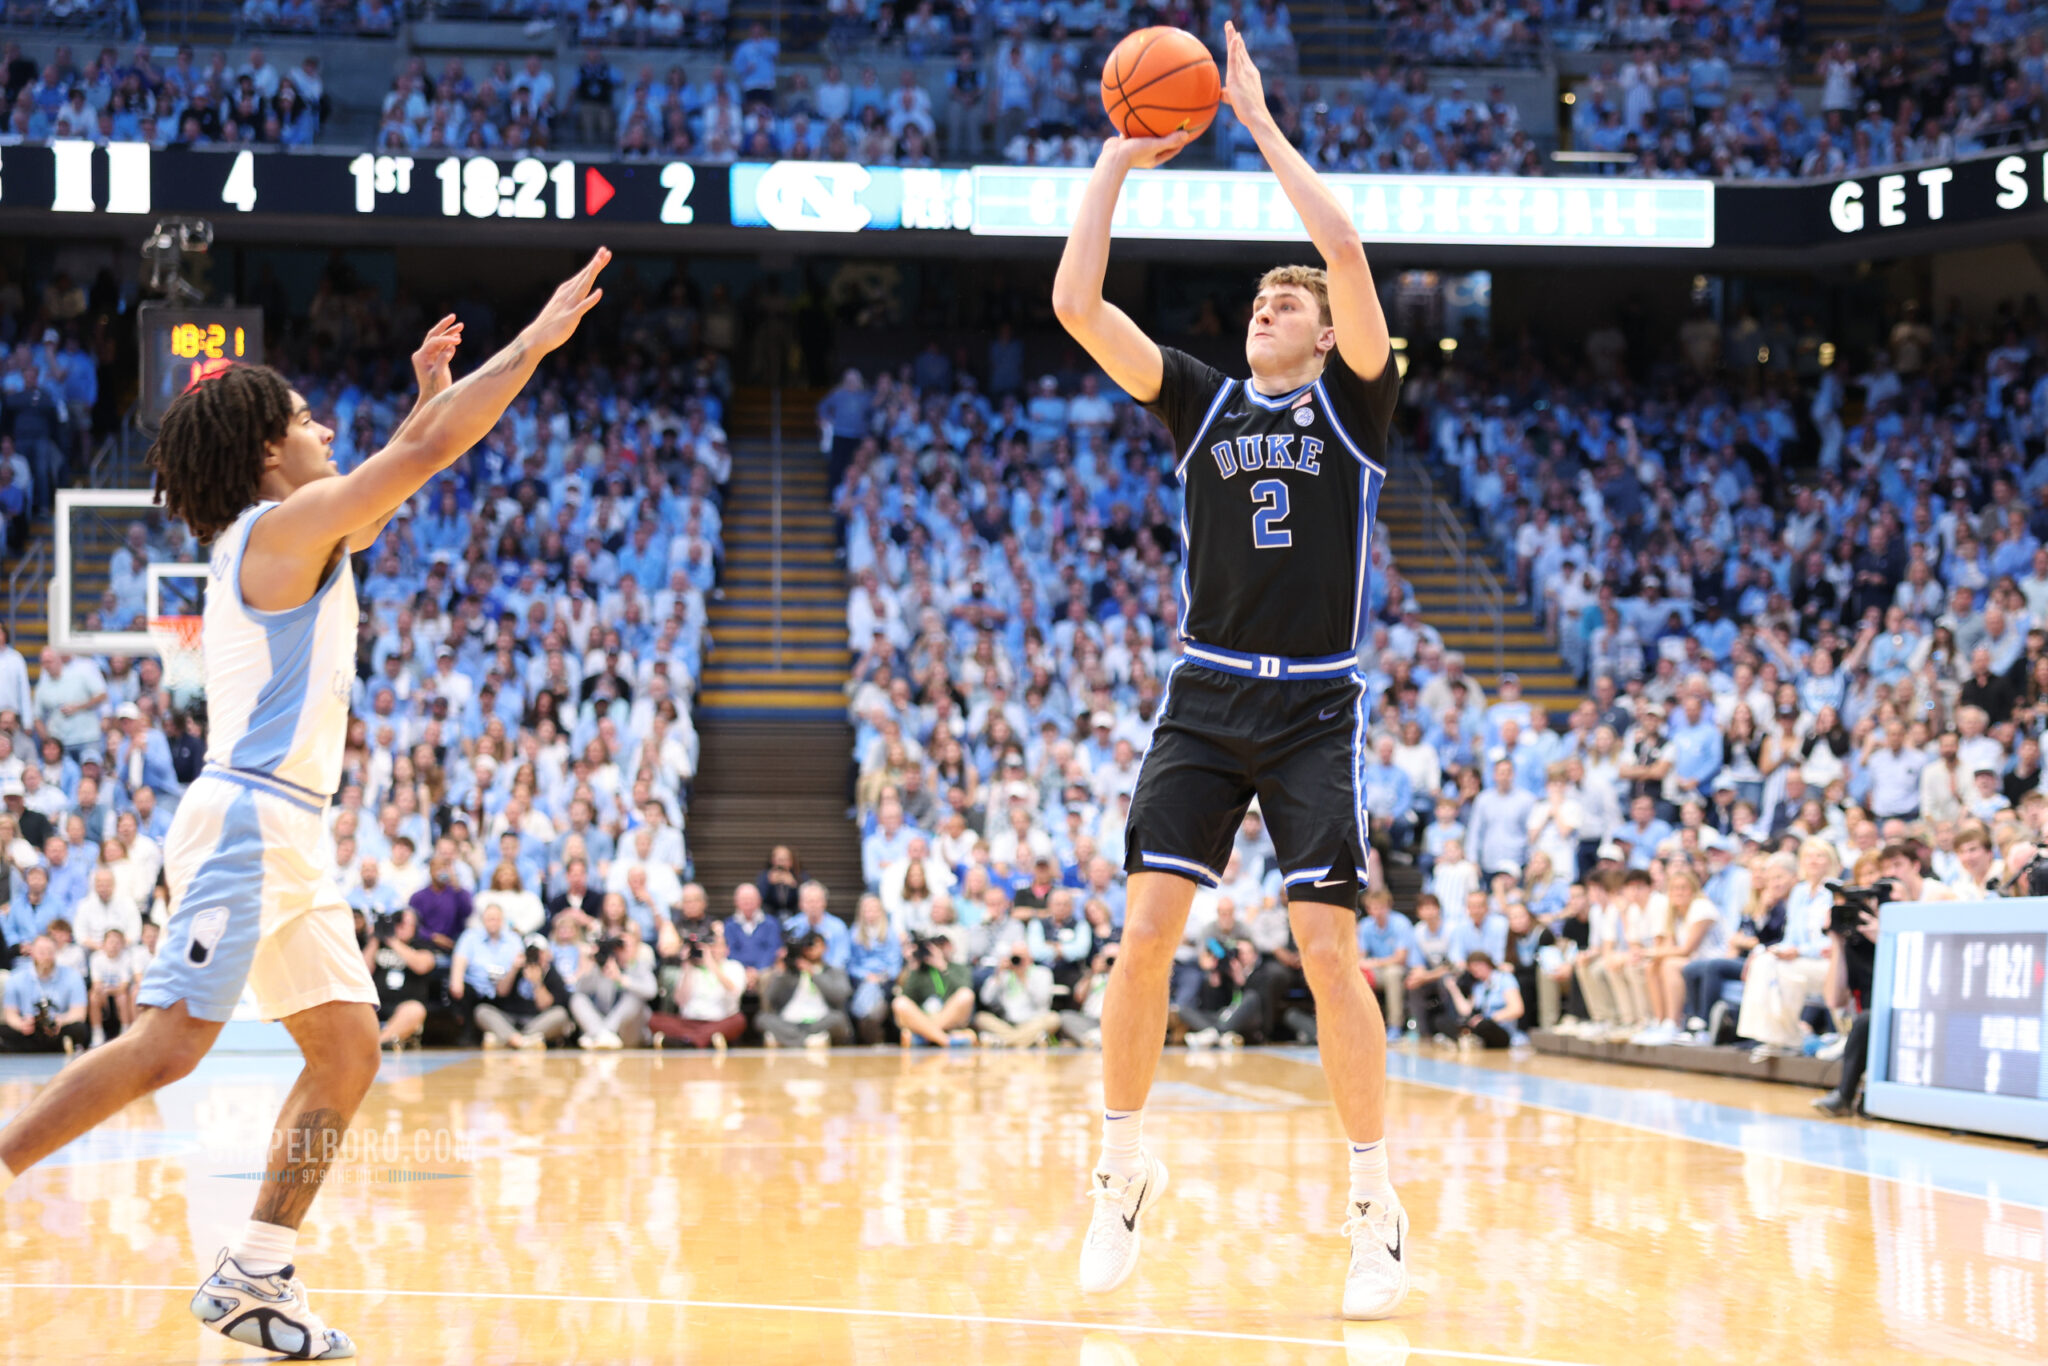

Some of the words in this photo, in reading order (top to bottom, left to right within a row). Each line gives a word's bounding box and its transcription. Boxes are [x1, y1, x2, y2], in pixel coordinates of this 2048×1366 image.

[222, 150, 257, 212] 4
[349, 152, 413, 213] 1ST
[436, 156, 576, 220] 18:21
[660, 161, 695, 224] 2
[1828, 167, 1953, 233] GET
[1995, 151, 2048, 210] S
[171, 323, 245, 359] 18:21
[1211, 434, 1324, 480] DUKE
[1250, 479, 1292, 549] 2
[1258, 656, 1281, 678] D
